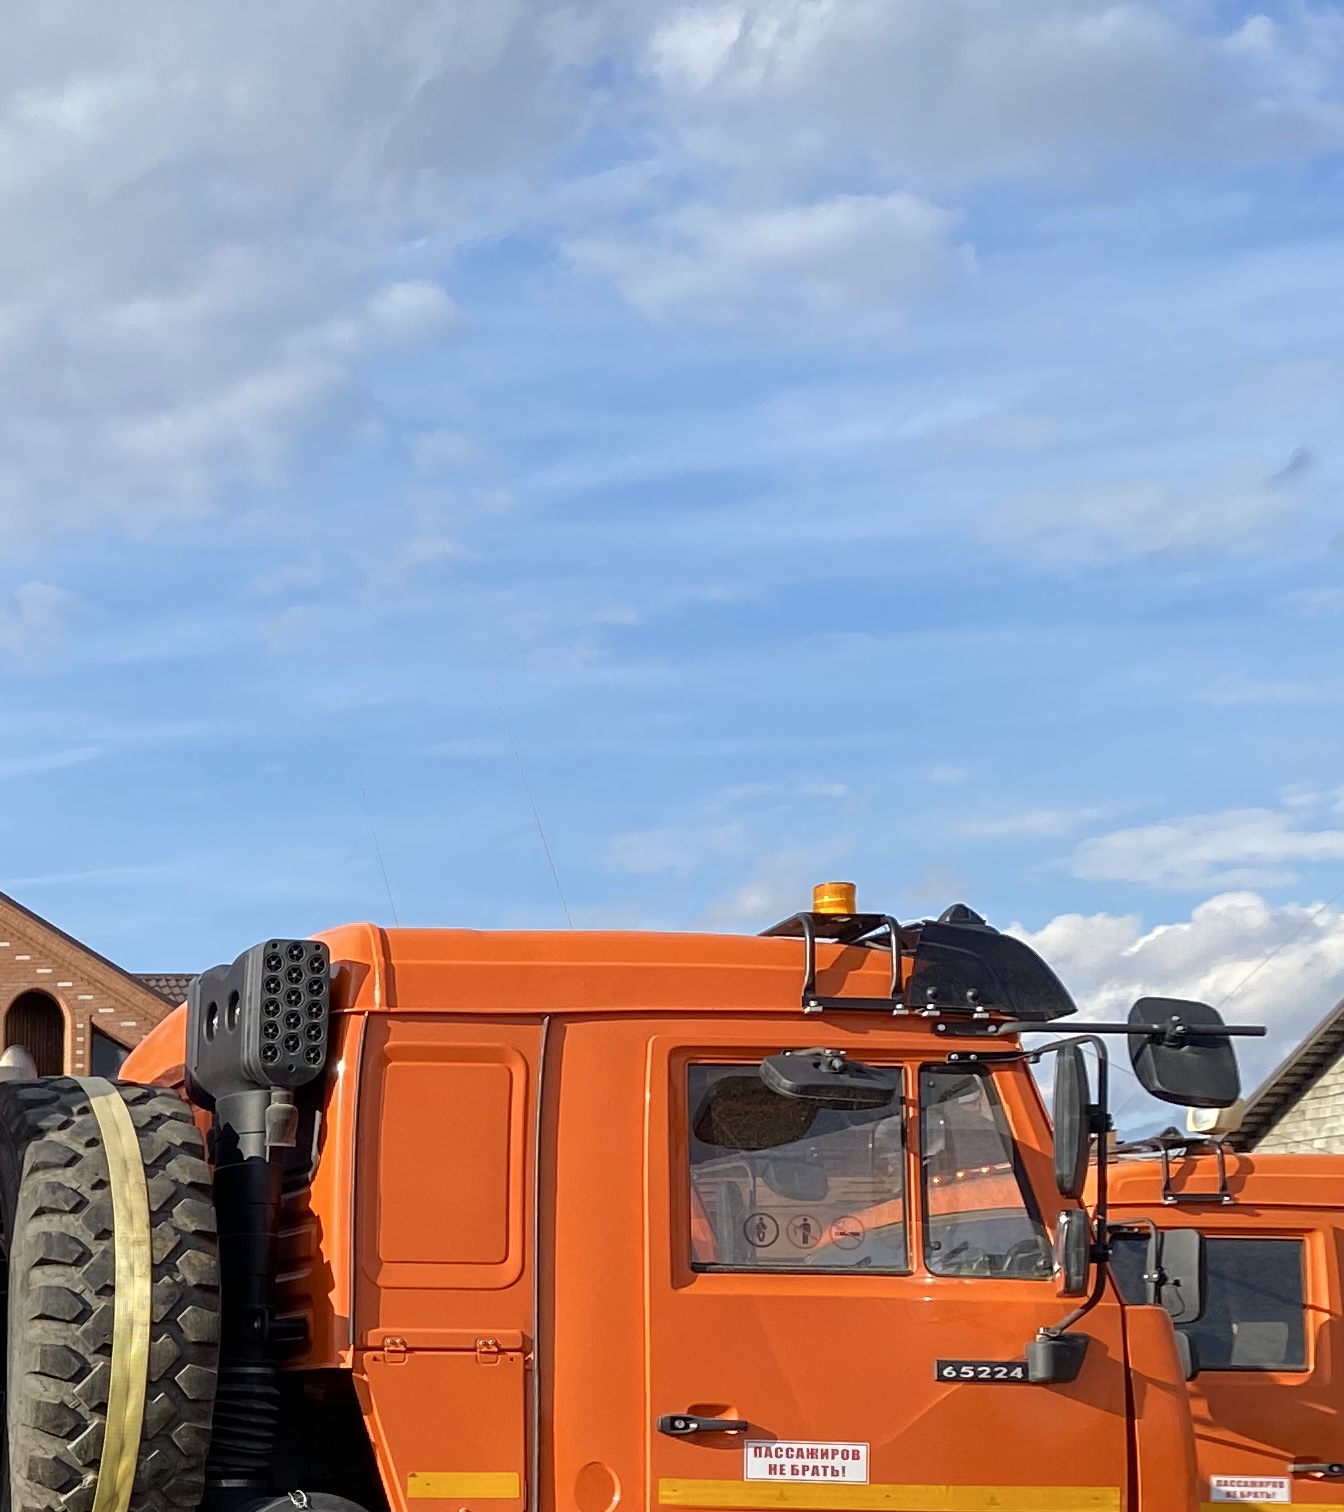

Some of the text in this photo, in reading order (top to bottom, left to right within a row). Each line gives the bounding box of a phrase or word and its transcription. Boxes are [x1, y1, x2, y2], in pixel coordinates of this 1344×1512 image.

[942, 1365, 1024, 1379] 65224
[753, 1445, 861, 1462] ПАССАЖИРОВ
[768, 1463, 846, 1478] НЕ БРАТЬ!
